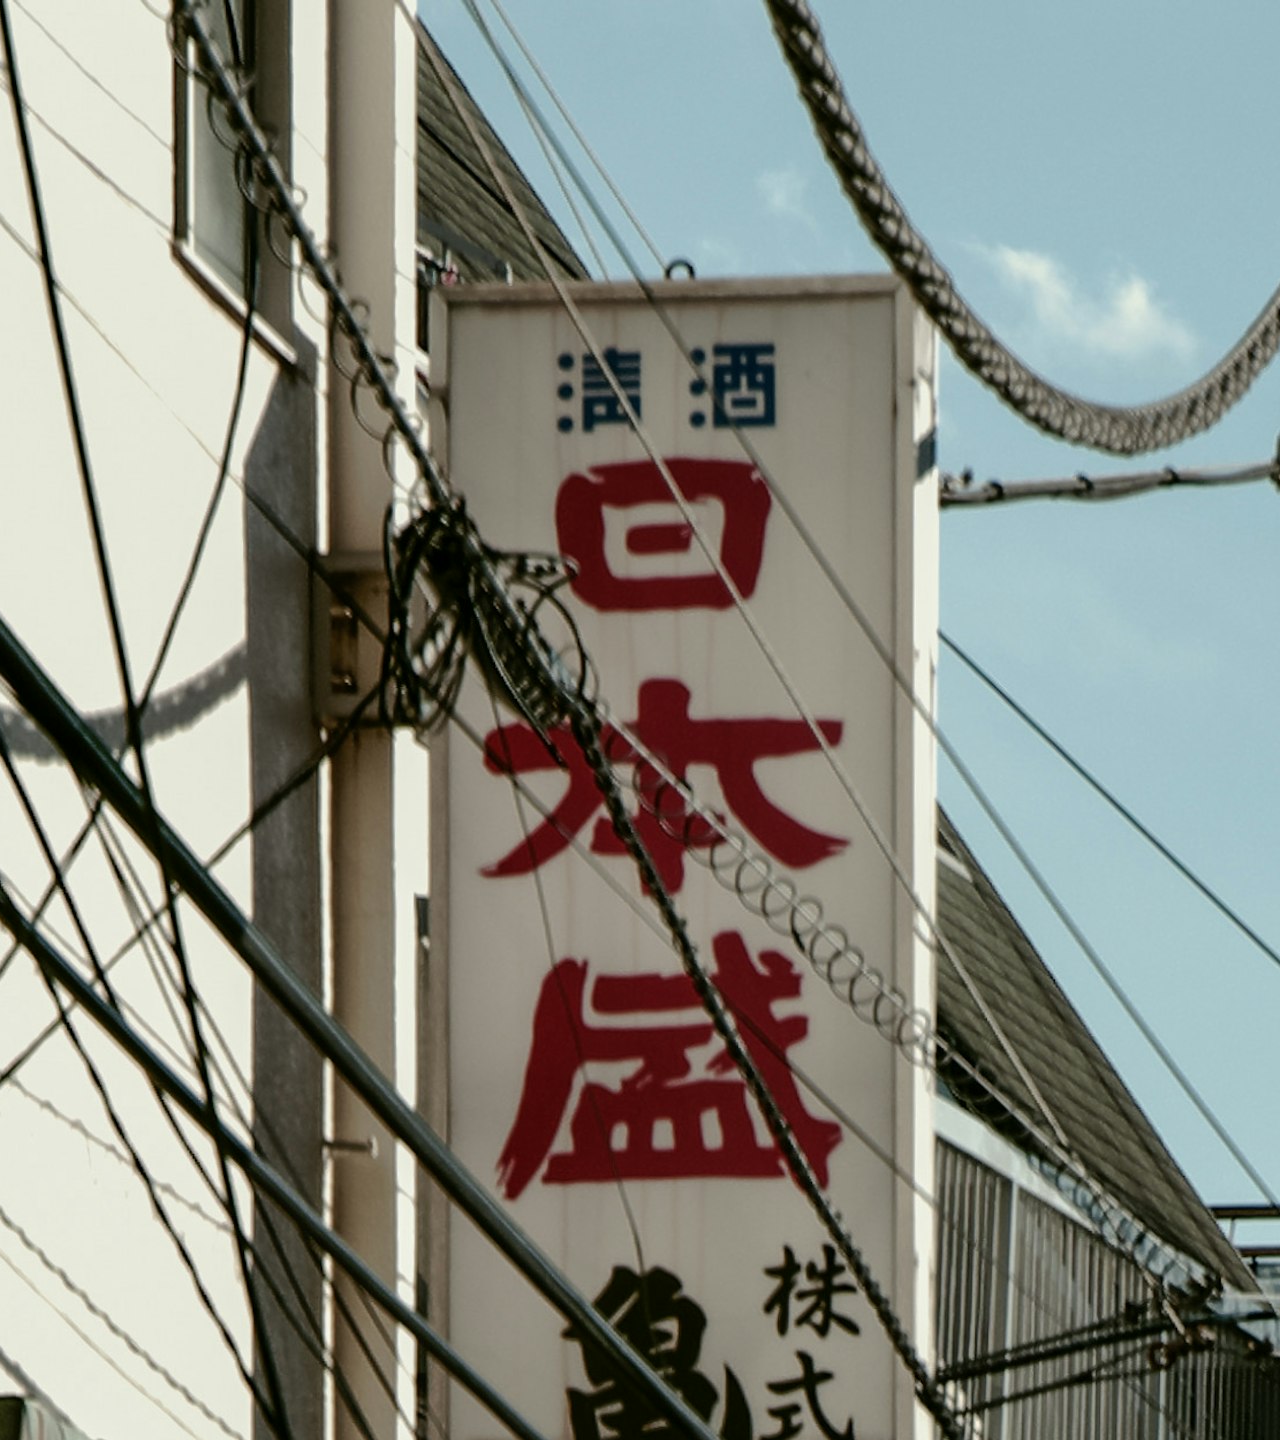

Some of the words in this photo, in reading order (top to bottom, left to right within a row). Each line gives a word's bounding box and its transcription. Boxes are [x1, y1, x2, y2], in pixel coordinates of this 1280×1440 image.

[557, 342, 777, 434] 清酒
[479, 457, 850, 1202] 日本盛
